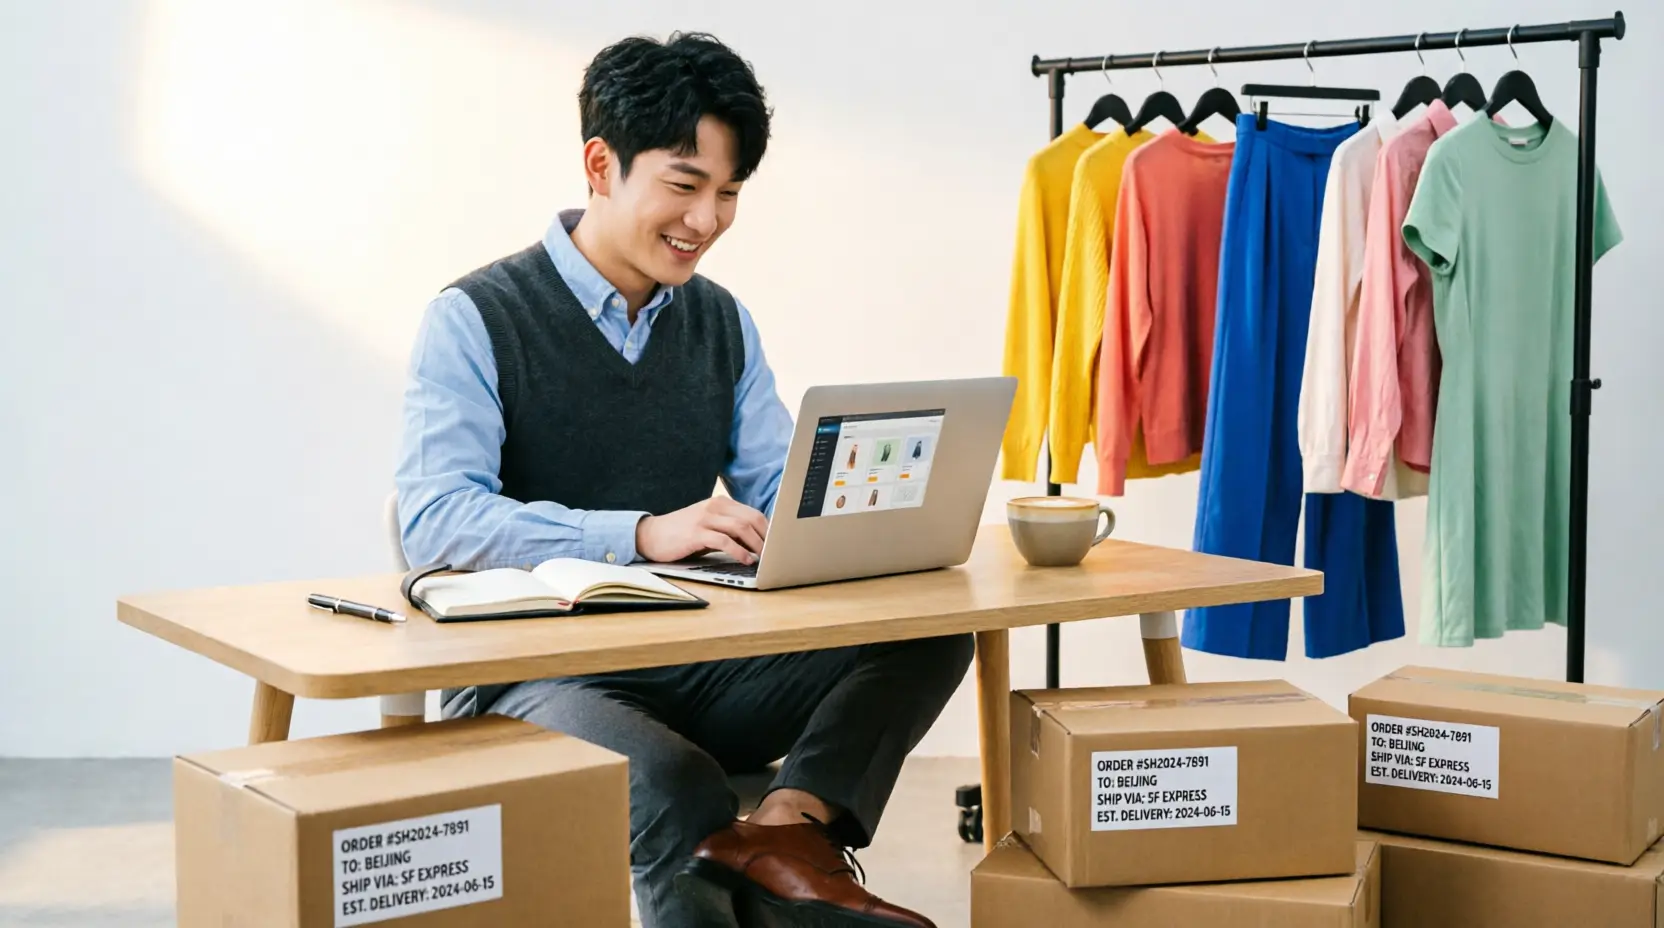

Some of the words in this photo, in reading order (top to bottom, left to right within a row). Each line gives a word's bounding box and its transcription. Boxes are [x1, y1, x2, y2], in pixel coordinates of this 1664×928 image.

[1371, 721, 1403, 736] ORDER
[1389, 738, 1426, 753] BEIJING
[1097, 759, 1133, 772] ORDER
[1136, 755, 1209, 770] #SH2024-7891
[1371, 751, 1393, 763] SHIP
[1394, 753, 1414, 767] VIA:
[1415, 756, 1427, 768] SF
[1428, 757, 1470, 773] EXPRESS
[1097, 776, 1116, 789] TO:
[1117, 774, 1158, 788] BEIJING
[1371, 765, 1390, 777] EST.
[1391, 767, 1439, 784] DELIVERY:
[1440, 774, 1492, 791] 2024-06-15
[1097, 793, 1122, 806] SHIP
[1162, 789, 1208, 803] EXPRESS
[1097, 810, 1119, 823] EST.
[1121, 808, 1173, 822] DELIVERY:
[1175, 805, 1231, 819] 2024-06-15
[341, 833, 383, 854] ORDER
[386, 819, 469, 846] #SH2024-7891
[342, 858, 362, 875] TO:
[364, 849, 412, 871] BEIJING
[341, 877, 372, 896] SHIP
[373, 873, 399, 890] VIA:
[401, 868, 416, 885] SF
[418, 859, 469, 882] EXPRESS
[342, 898, 367, 916] EST.
[369, 888, 430, 911] DELIVERY:
[431, 875, 495, 900] 2024-06-15
